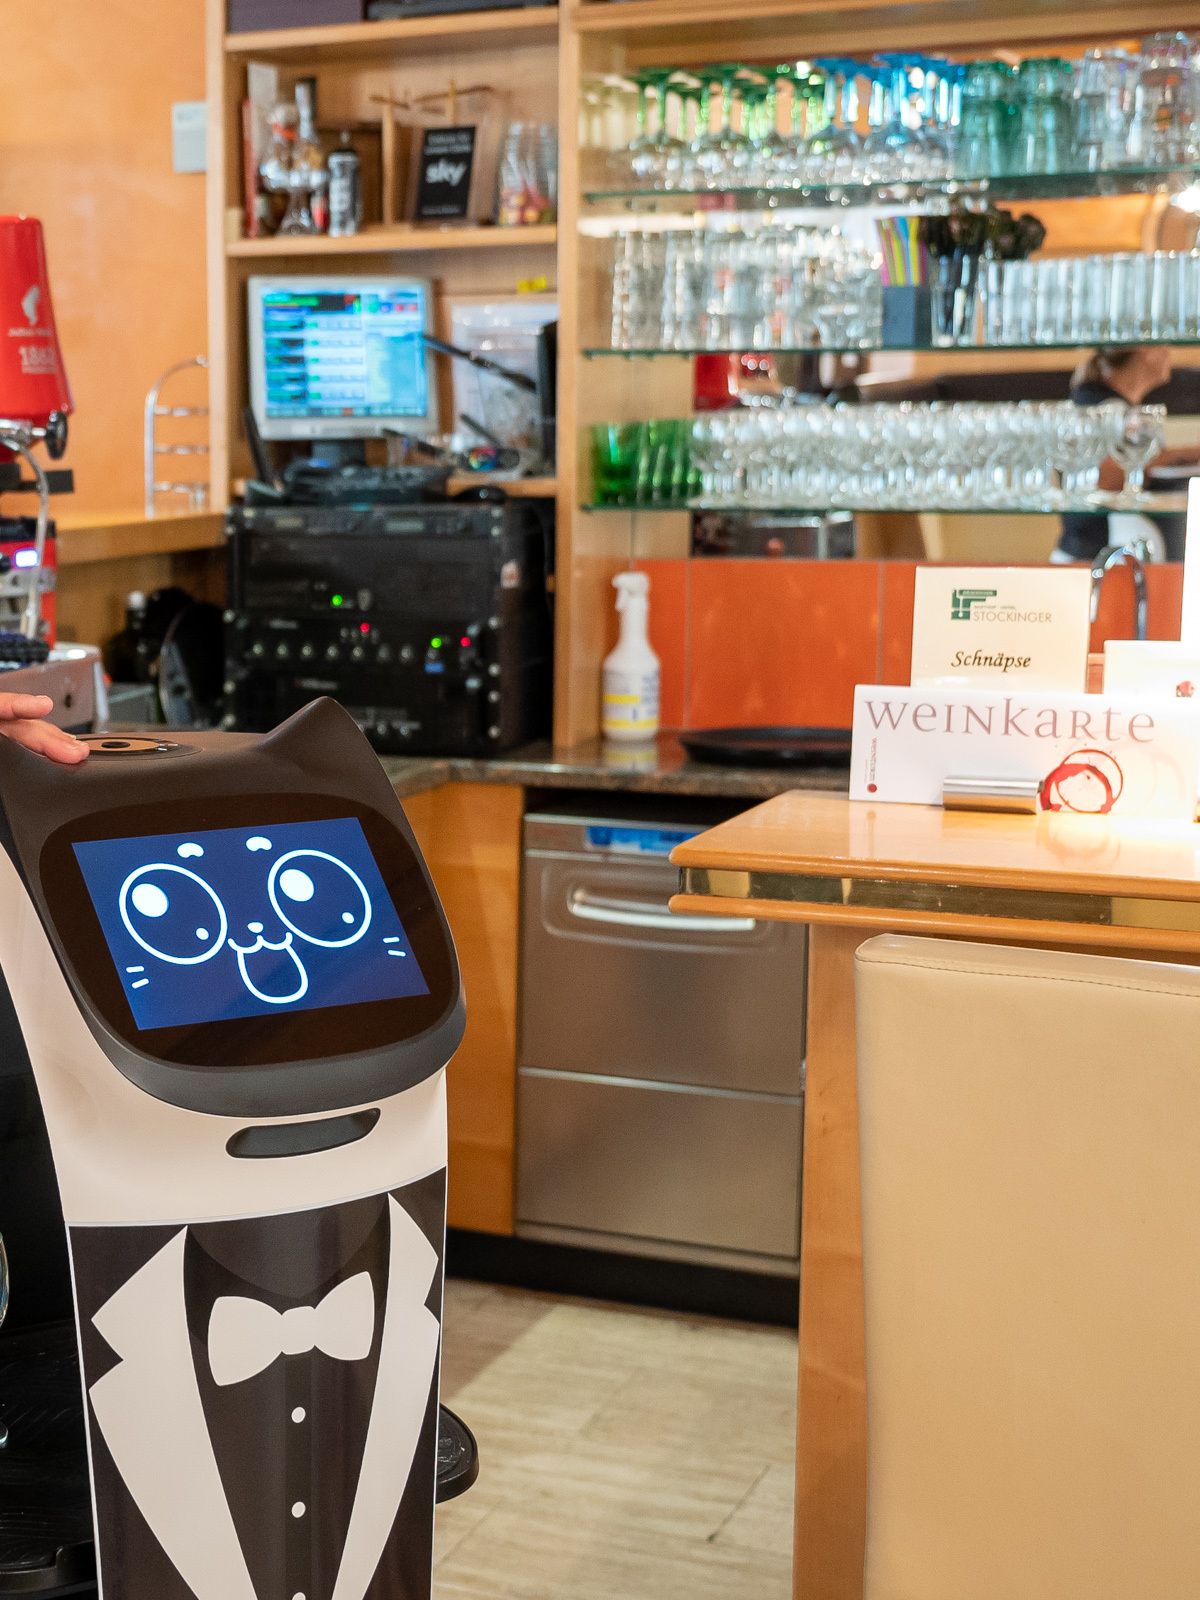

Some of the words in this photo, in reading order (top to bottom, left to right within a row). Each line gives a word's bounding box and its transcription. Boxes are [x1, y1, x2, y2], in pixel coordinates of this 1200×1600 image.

[426, 159, 467, 187] sky
[973, 611, 1053, 623] STOCKINGER
[951, 649, 1032, 673] Schnäpse
